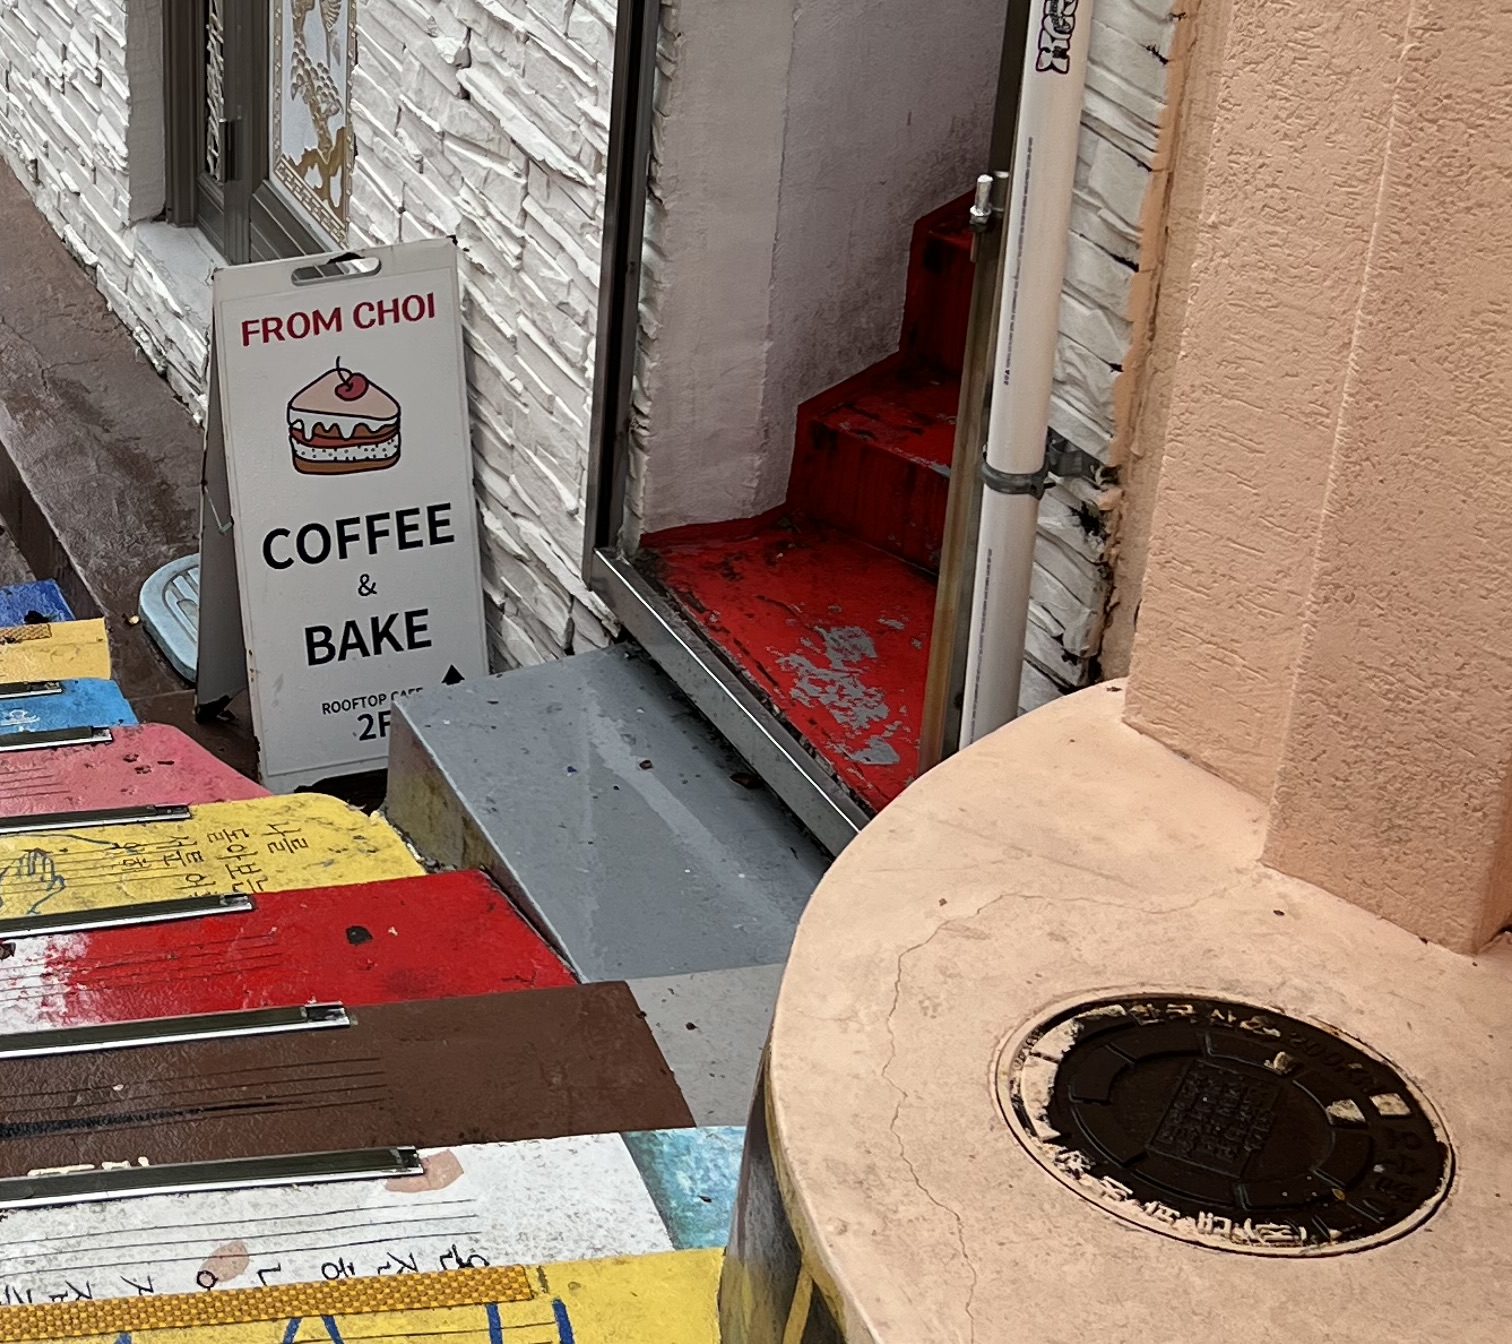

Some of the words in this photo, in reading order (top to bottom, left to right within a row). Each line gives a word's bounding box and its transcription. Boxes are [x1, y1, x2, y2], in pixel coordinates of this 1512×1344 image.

[240, 306, 344, 348] FROM
[352, 292, 437, 327] CHOI
[262, 501, 455, 571] COFFEE
[357, 574, 378, 597] &
[304, 608, 433, 668] BAKE
[321, 693, 386, 716] ROOFTOP
[261, 820, 310, 855] 나를
